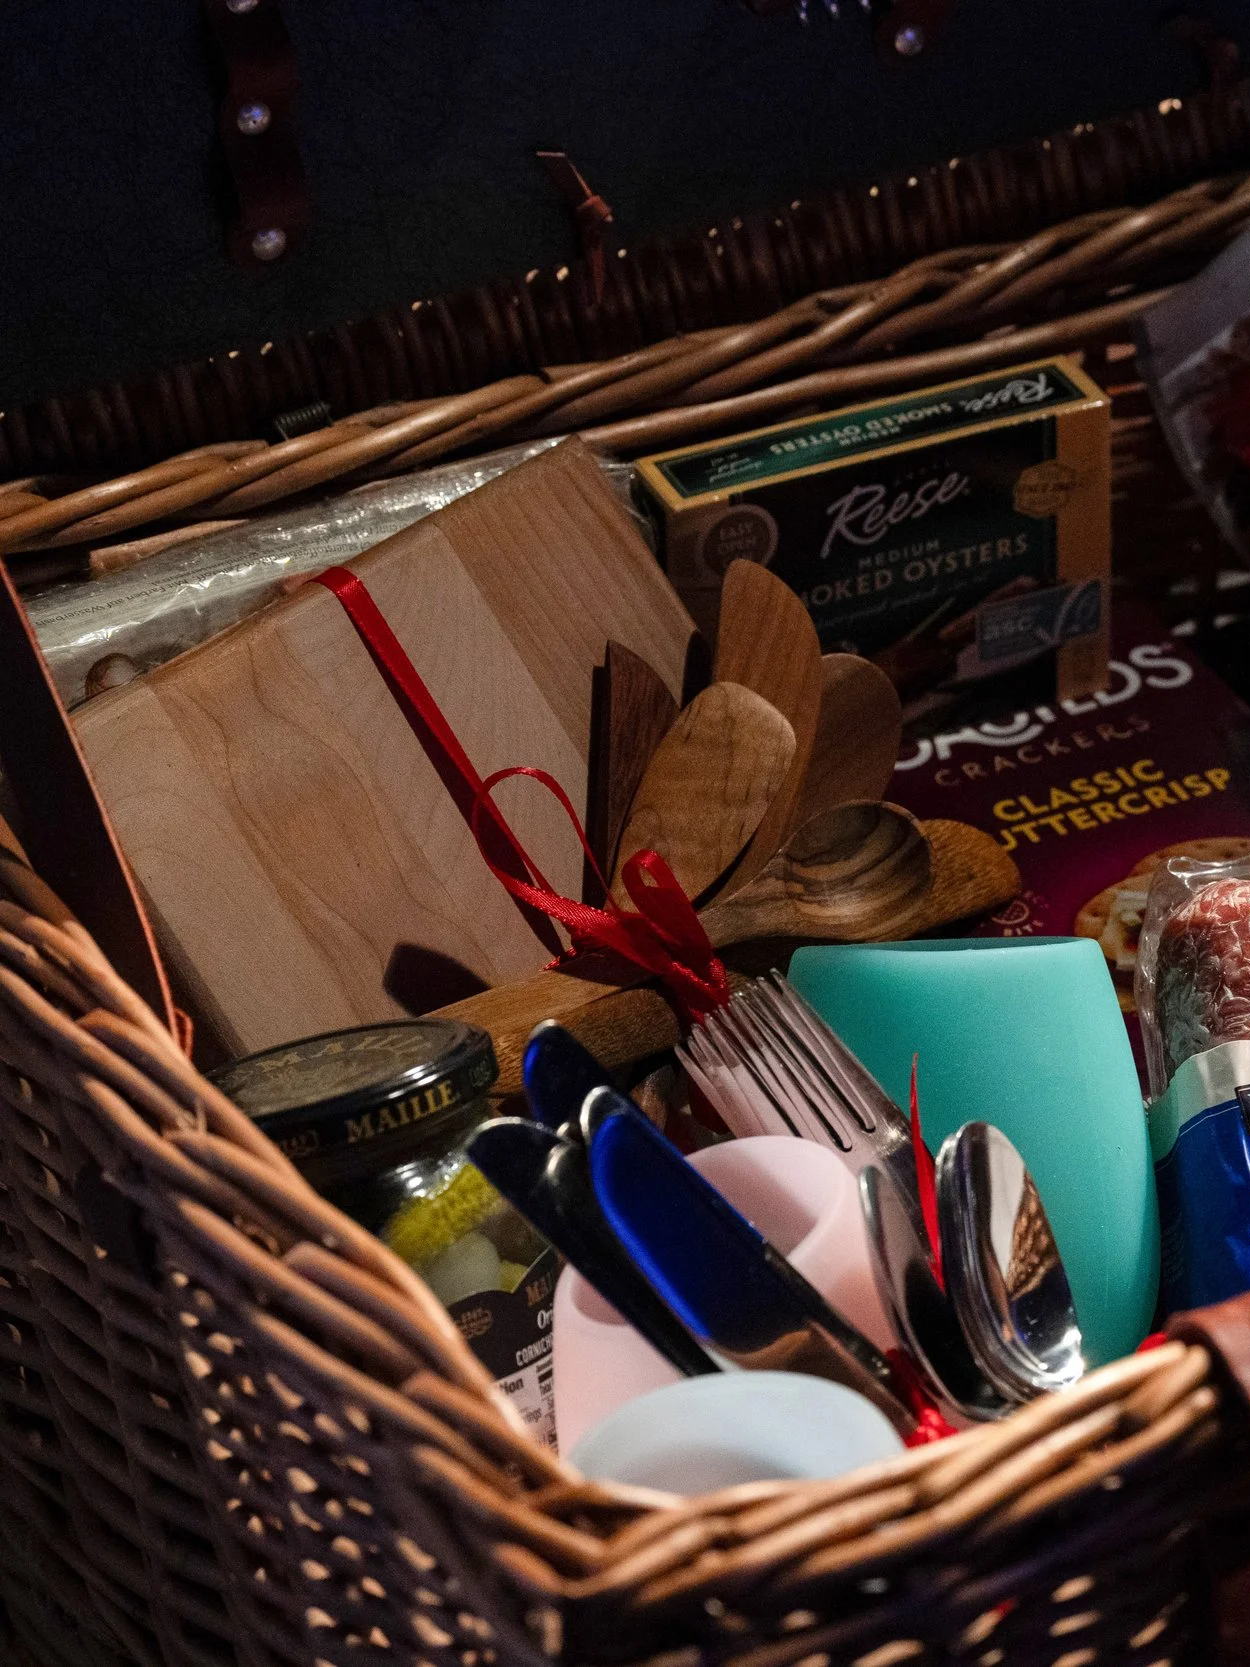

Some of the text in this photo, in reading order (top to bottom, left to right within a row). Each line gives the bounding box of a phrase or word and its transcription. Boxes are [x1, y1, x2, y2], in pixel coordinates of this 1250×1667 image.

[964, 373, 1054, 411] Reese
[769, 401, 953, 456] SMOKED OYSTERS
[820, 472, 970, 559] Reese
[803, 568, 895, 608] OKED
[903, 533, 1029, 584] OYSTERS
[858, 538, 941, 570] MEDIUM
[35, 604, 107, 628] Wasserbasis
[107, 596, 126, 610] auf
[127, 585, 167, 602] Farben
[934, 716, 1151, 788] CRACKERS
[993, 758, 1164, 824] CLASSIC
[344, 1079, 460, 1144] MAILLE
